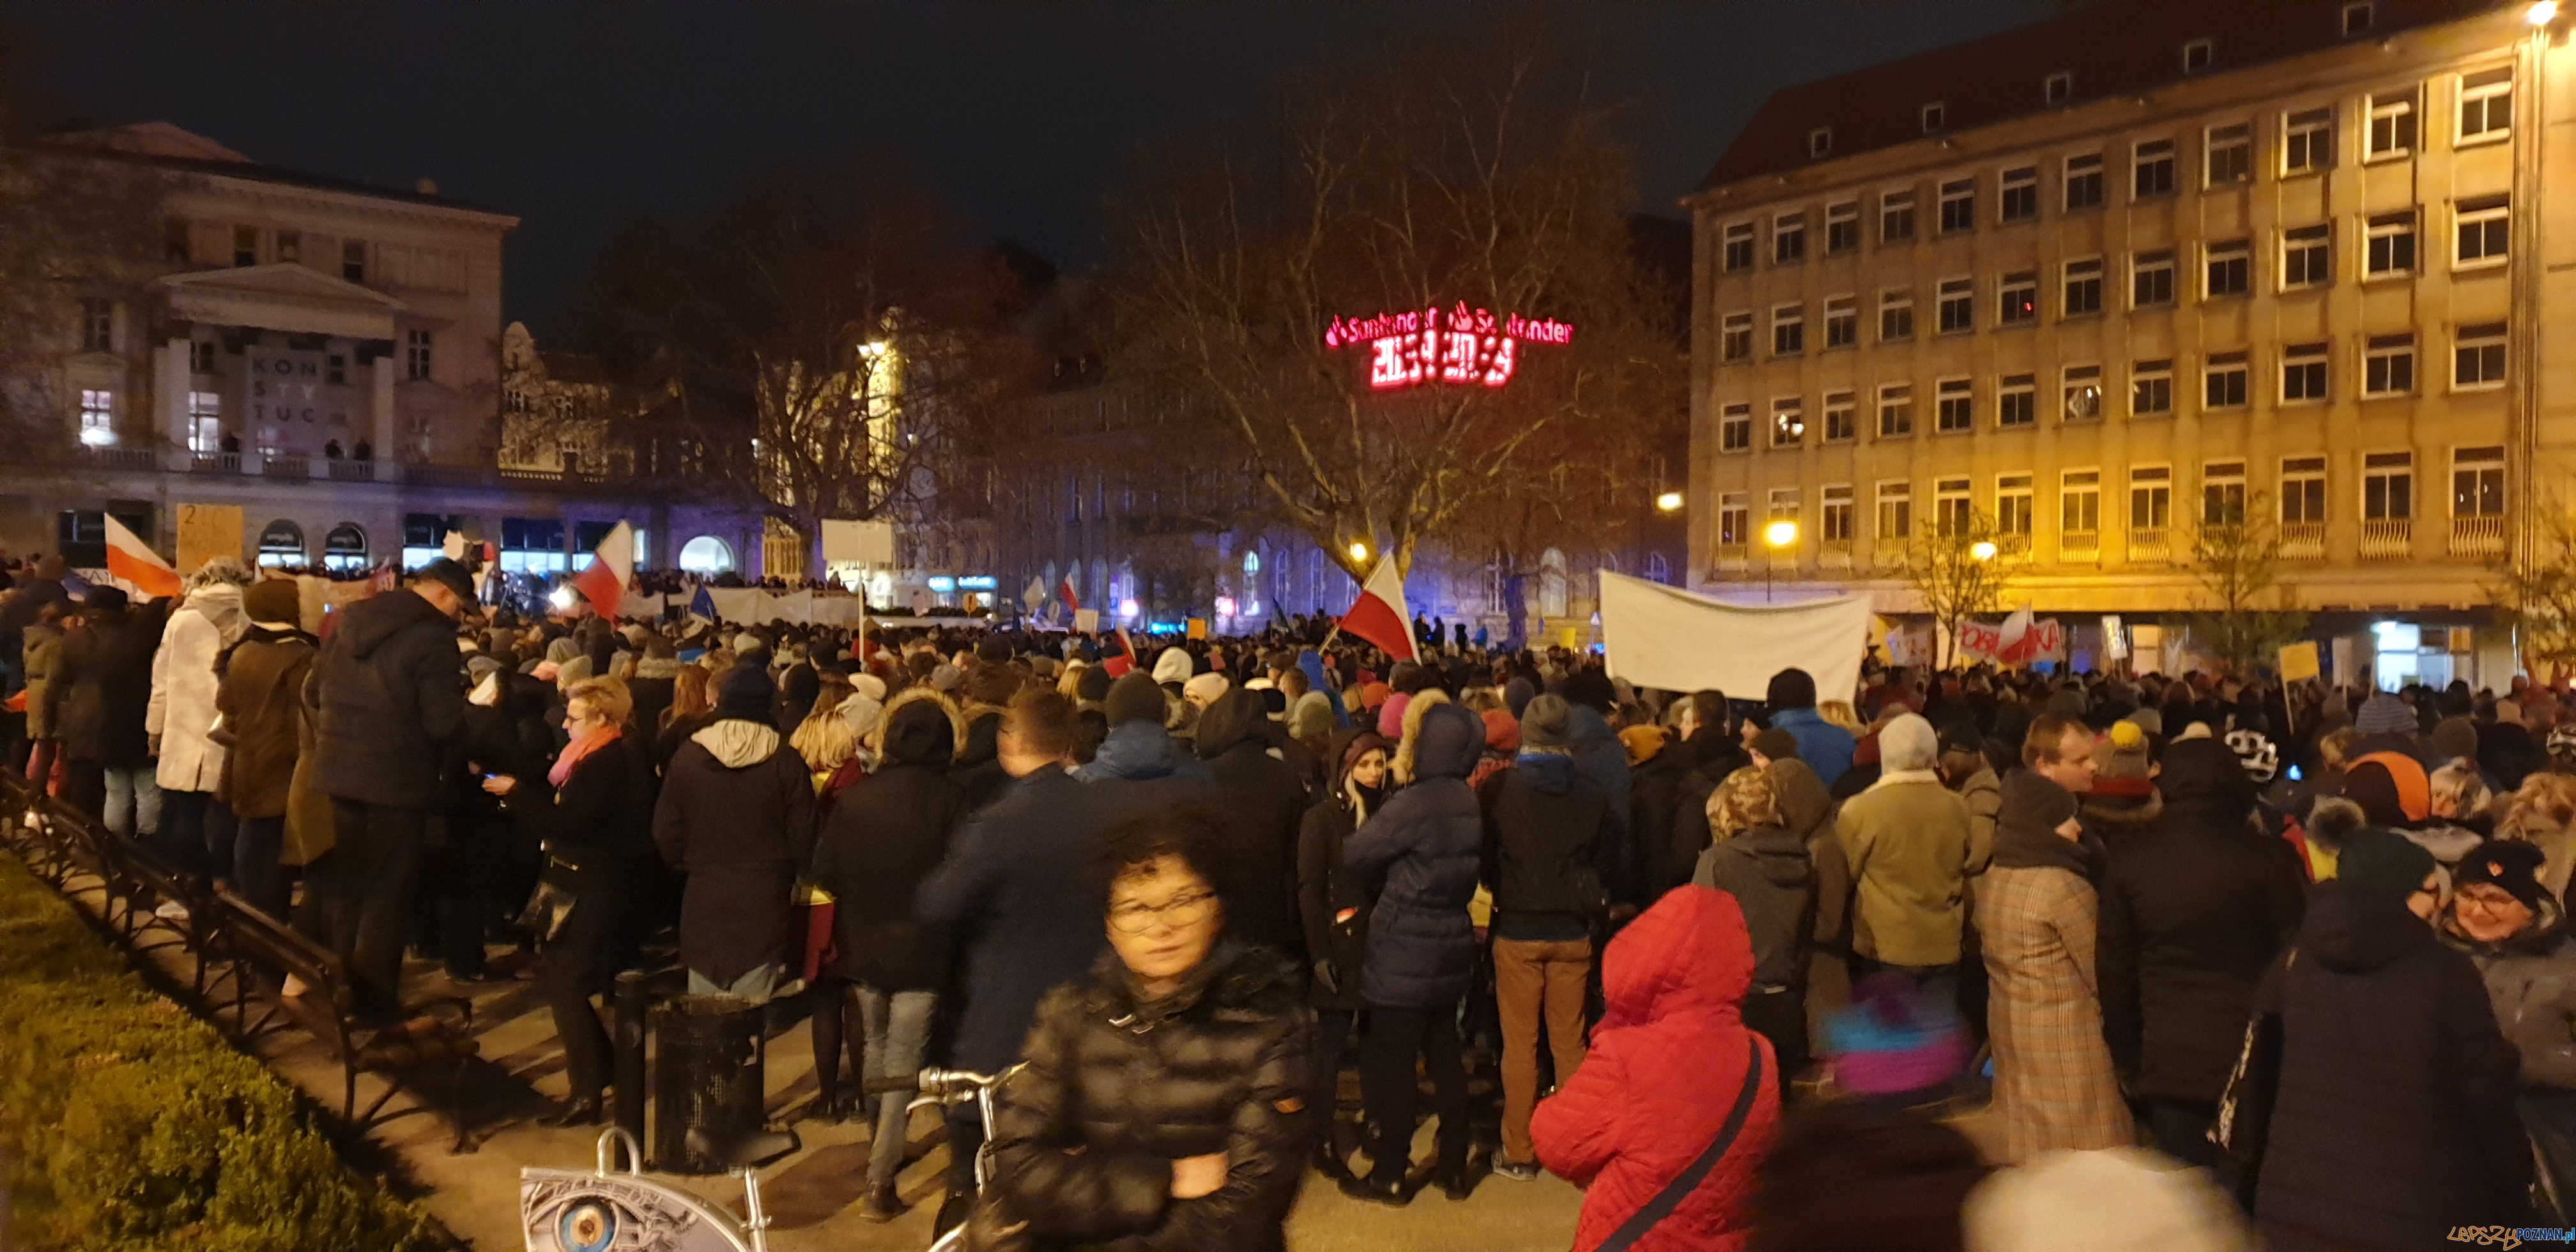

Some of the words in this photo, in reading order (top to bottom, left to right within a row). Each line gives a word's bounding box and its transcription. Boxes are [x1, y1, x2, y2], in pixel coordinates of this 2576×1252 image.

[1348, 307, 1438, 343] Santandr
[254, 359, 316, 377] KON
[255, 404, 315, 424] TUC
